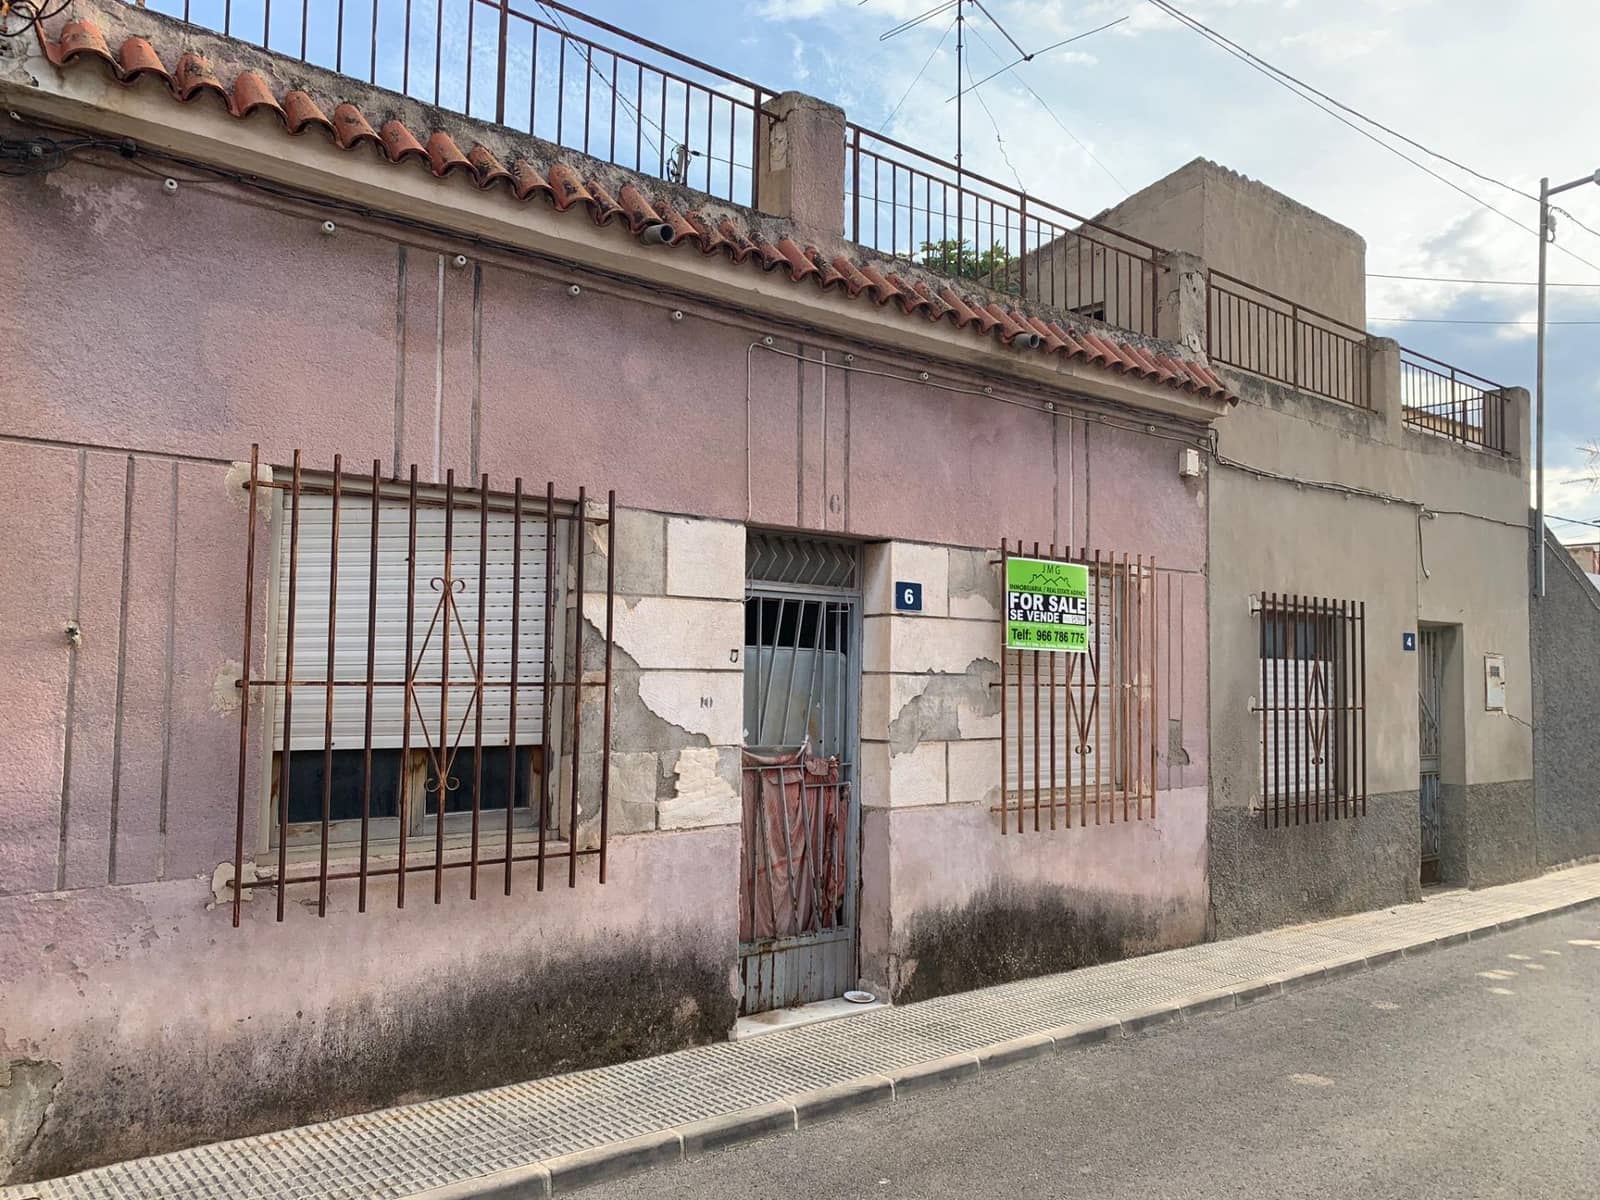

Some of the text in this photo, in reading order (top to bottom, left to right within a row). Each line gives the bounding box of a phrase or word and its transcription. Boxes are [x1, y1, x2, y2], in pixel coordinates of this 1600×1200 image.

[1041, 564, 1061, 575] JMG
[904, 588, 914, 605] 6
[1009, 592, 1086, 615] FOR SALE
[1009, 609, 1024, 620] SE
[1026, 610, 1060, 623] VENDE
[1012, 628, 1085, 644] Telf: 966 786 775
[1406, 636, 1412, 647] 4
